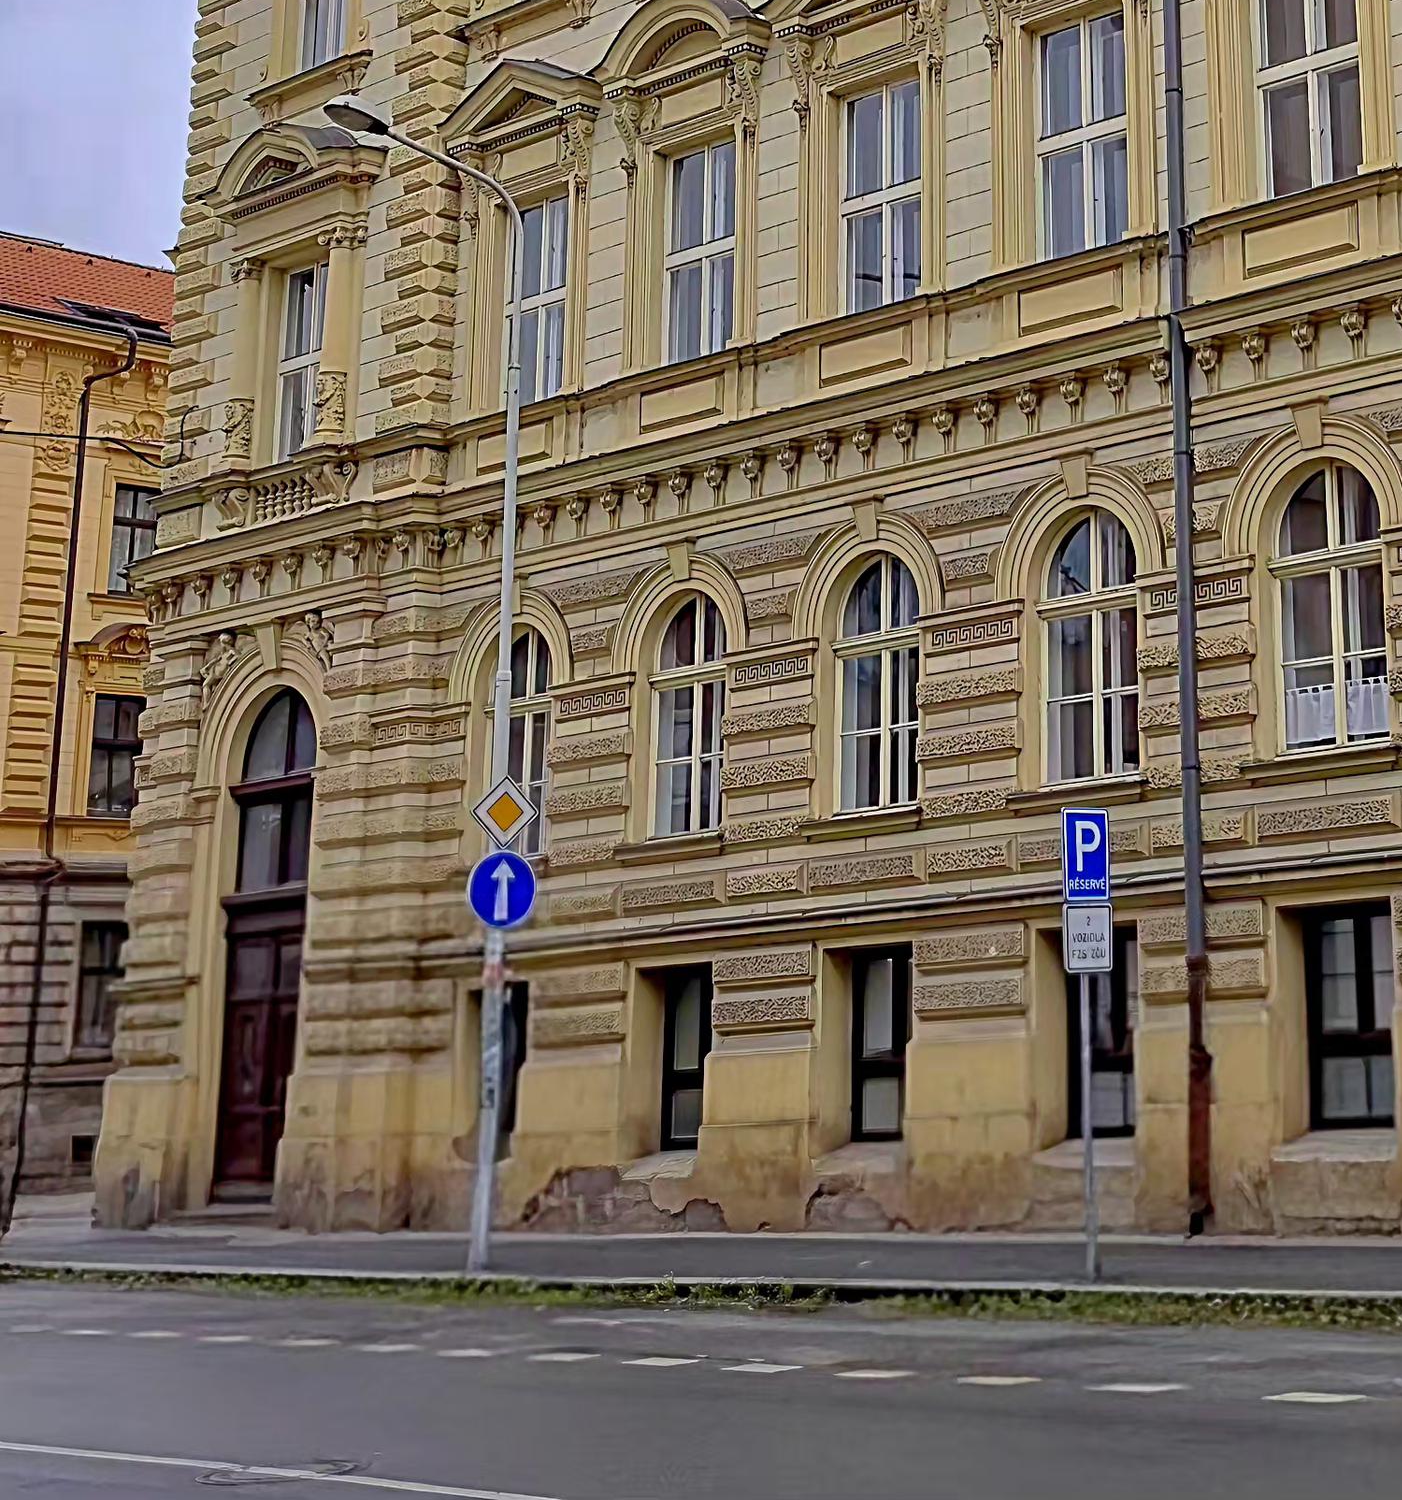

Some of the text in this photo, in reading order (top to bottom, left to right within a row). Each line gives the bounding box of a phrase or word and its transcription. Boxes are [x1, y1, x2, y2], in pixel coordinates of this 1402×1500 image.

[1075, 820, 1101, 872] P
[1069, 877, 1106, 890] RÉSERVÉ
[1086, 915, 1091, 926] 2
[1072, 932, 1106, 943] VOZIDLA
